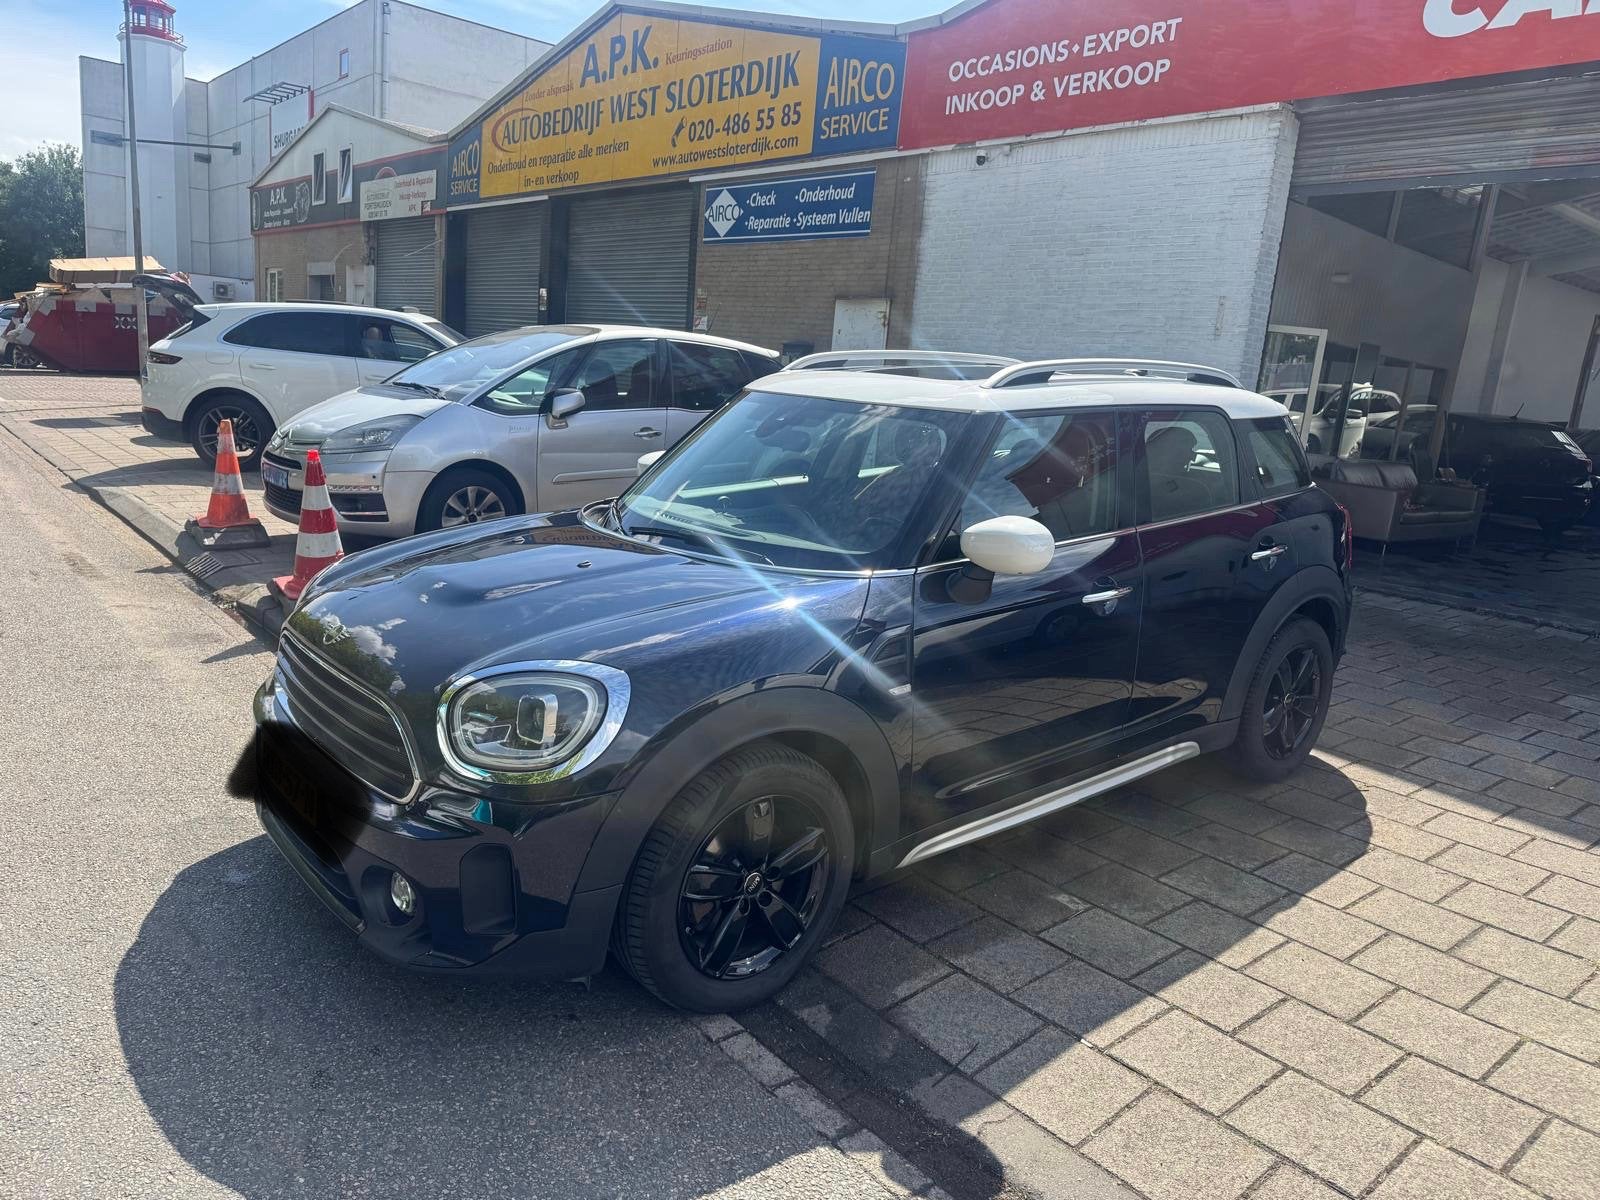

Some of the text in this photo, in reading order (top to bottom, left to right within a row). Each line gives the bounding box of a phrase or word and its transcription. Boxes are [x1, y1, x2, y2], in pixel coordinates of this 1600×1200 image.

[665, 37, 733, 65] Keuringsstation
[1082, 17, 1182, 57] EXPORT
[579, 25, 659, 88] A.P.K.
[501, 50, 801, 147] AUTOBEDRIJF WEST SLOTERDIJK
[823, 56, 895, 110] AIRCO
[945, 58, 1171, 115] INKOOP & VERKOOP
[688, 101, 802, 143] 020-486 55 85
[820, 107, 889, 140] SERVICE
[451, 139, 480, 178] AIRCO
[487, 139, 630, 175] Onderhoud en reparatie alle merken
[652, 135, 799, 169] www.autowestsloterdijk.com
[450, 178, 478, 196] SERVICE
[546, 170, 580, 185] verkoop
[799, 182, 856, 203] Onderhoud
[706, 203, 742, 222] AIRCO
[749, 191, 776, 207] Check
[747, 213, 790, 232] Reparatie
[795, 207, 871, 230] Systeem Vullen
